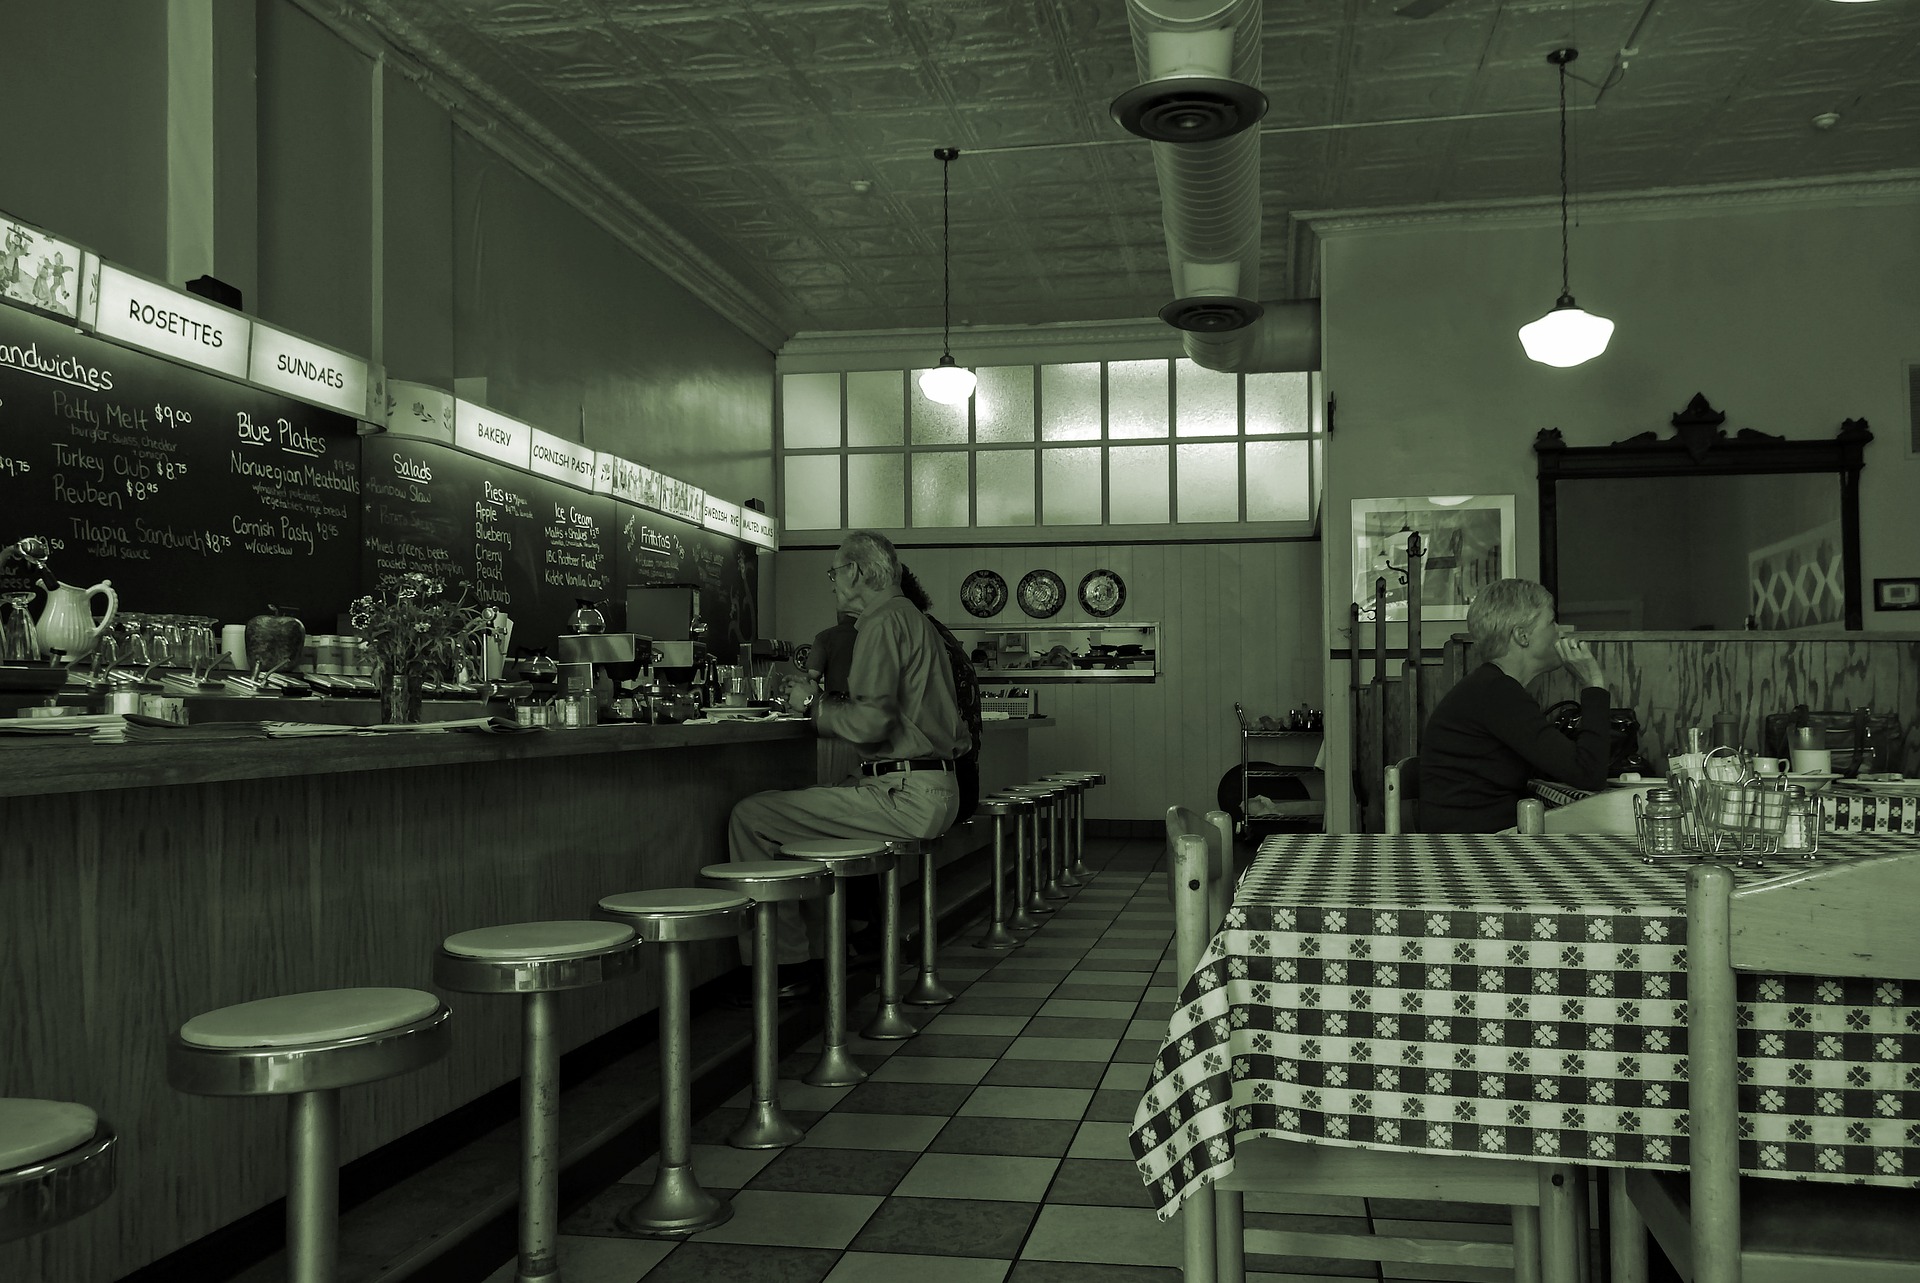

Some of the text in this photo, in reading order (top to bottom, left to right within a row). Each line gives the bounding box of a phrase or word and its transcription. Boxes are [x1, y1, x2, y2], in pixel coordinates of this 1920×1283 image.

[129, 299, 223, 348] ROSETTES
[0, 342, 114, 390] andwiches
[277, 354, 344, 389] SUNDAES
[53, 390, 100, 429] Patty
[106, 403, 148, 431] Melt
[237, 411, 326, 453] Blue Plates
[478, 422, 512, 447] BAKERY
[52, 443, 104, 482] Turkey
[114, 454, 150, 480] Club
[231, 450, 303, 489] Norwegian
[304, 465, 360, 494] Meatballs
[393, 453, 432, 481] Salads
[533, 445, 596, 478] CORNISH PASTY
[53, 474, 122, 510] Reuben
[485, 481, 504, 502] Pies
[476, 501, 497, 523] Apple
[554, 502, 566, 521] Ice
[570, 506, 593, 528] Cream
[704, 506, 739, 527] SWEDISH RYE
[69, 517, 130, 547] Tilapia
[135, 517, 206, 556] Sandwich
[233, 515, 275, 537] Cornish
[281, 516, 314, 555] Pasty
[476, 522, 512, 551] Blueberry
[476, 543, 503, 571] Cherry
[476, 561, 503, 581] Peach
[477, 580, 511, 605] Rhubarb
